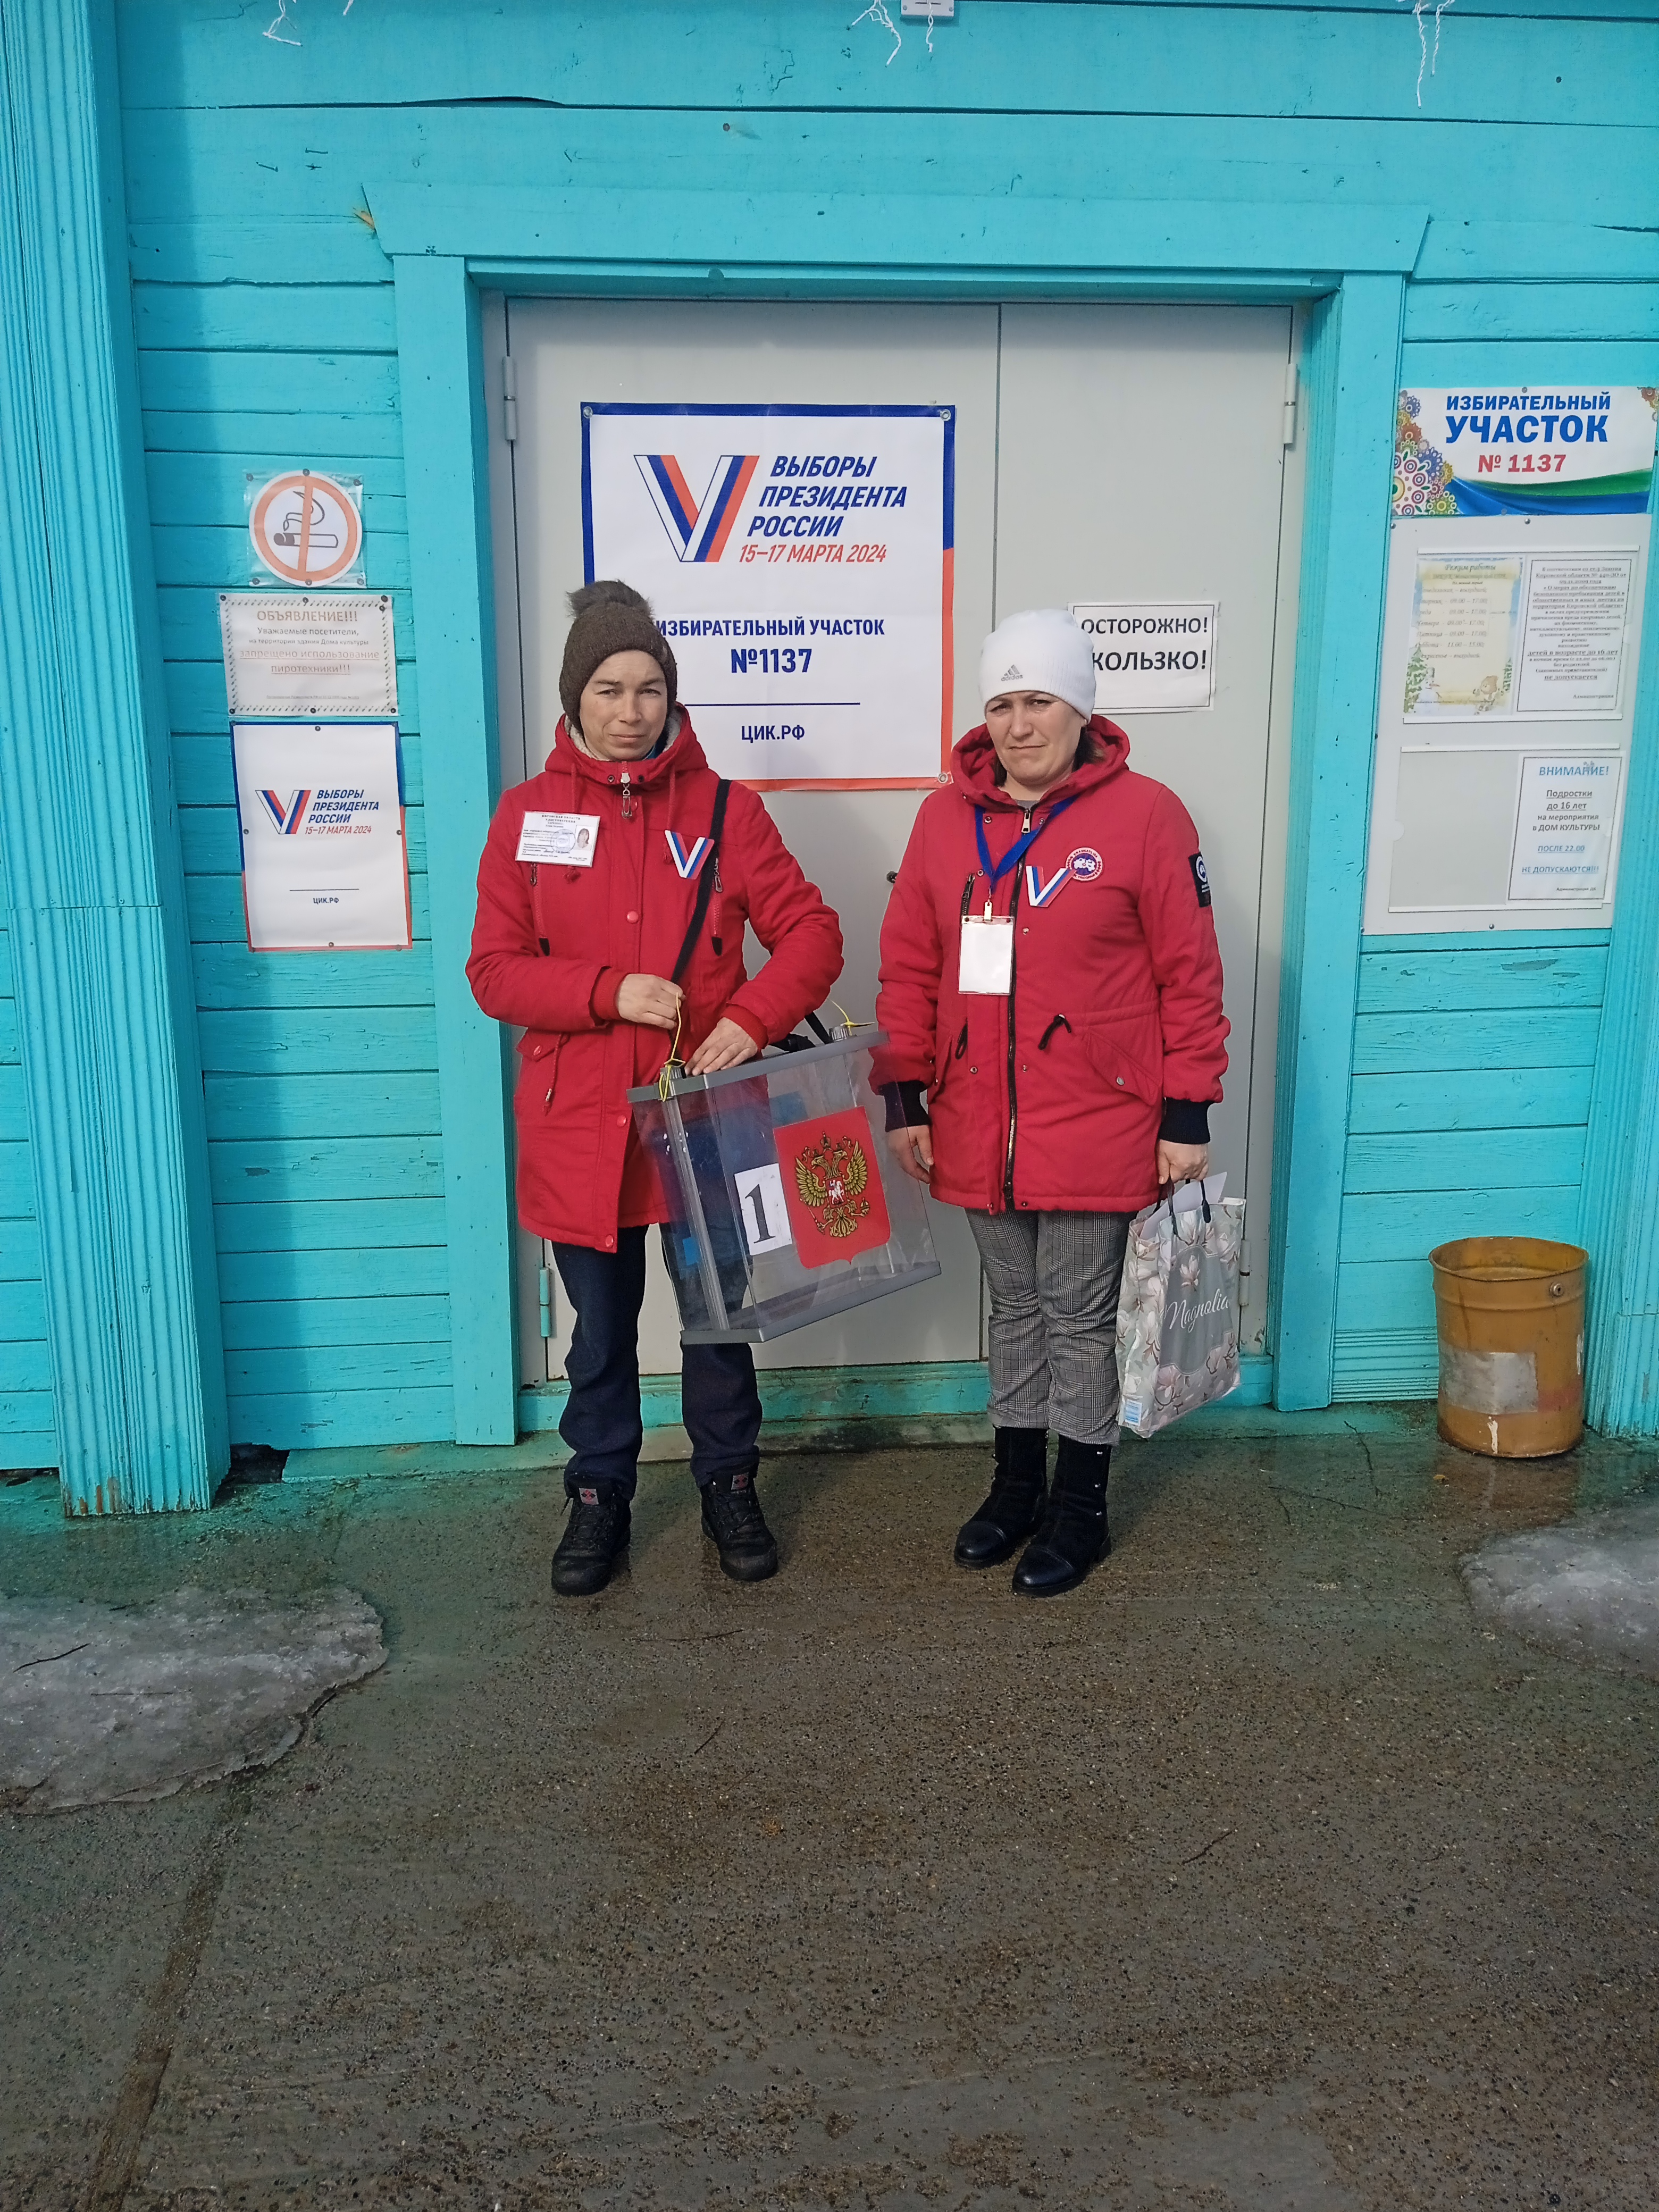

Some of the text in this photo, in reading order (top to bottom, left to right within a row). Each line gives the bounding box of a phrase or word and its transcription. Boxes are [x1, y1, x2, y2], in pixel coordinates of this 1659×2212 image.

[1446, 391, 1611, 410] ИЗБИРАТЕЛЬНЫЙ
[1445, 415, 1608, 443] УЧАСТОК
[770, 456, 877, 477] ВЫБОРЫ
[1478, 454, 1566, 473] № 1137
[759, 486, 907, 510] ПРЕЗИДЕНТА
[747, 516, 844, 537] РОССИИ
[786, 544, 843, 563] МАРТА
[846, 544, 887, 563] 2024
[257, 610, 358, 622] ОБЪЯВЛЕНИЕ!!!
[656, 615, 885, 636] ИЗБИРАТЕЛЬНЫЙ УЧАСТОК
[1081, 617, 1208, 634] ОСТОРОЖНО!
[240, 650, 380, 659] запрещено использование
[731, 649, 812, 674] №1137
[1092, 650, 1206, 671] КОЛЬЗКО!
[271, 664, 350, 674] пиротехники!!!
[741, 724, 805, 743] ЦИК.РФ
[1539, 766, 1609, 776] ВНИМАНИЕ!
[317, 789, 365, 799] ВЫБОРЫ
[313, 801, 379, 812] ПРЕЗИДЕНТА
[308, 814, 351, 824] РОССИИ
[326, 826, 353, 834] МАРТА
[353, 826, 372, 834] 2024
[744, 1184, 776, 1244] 1
[1164, 1288, 1229, 1333] Magnolia
